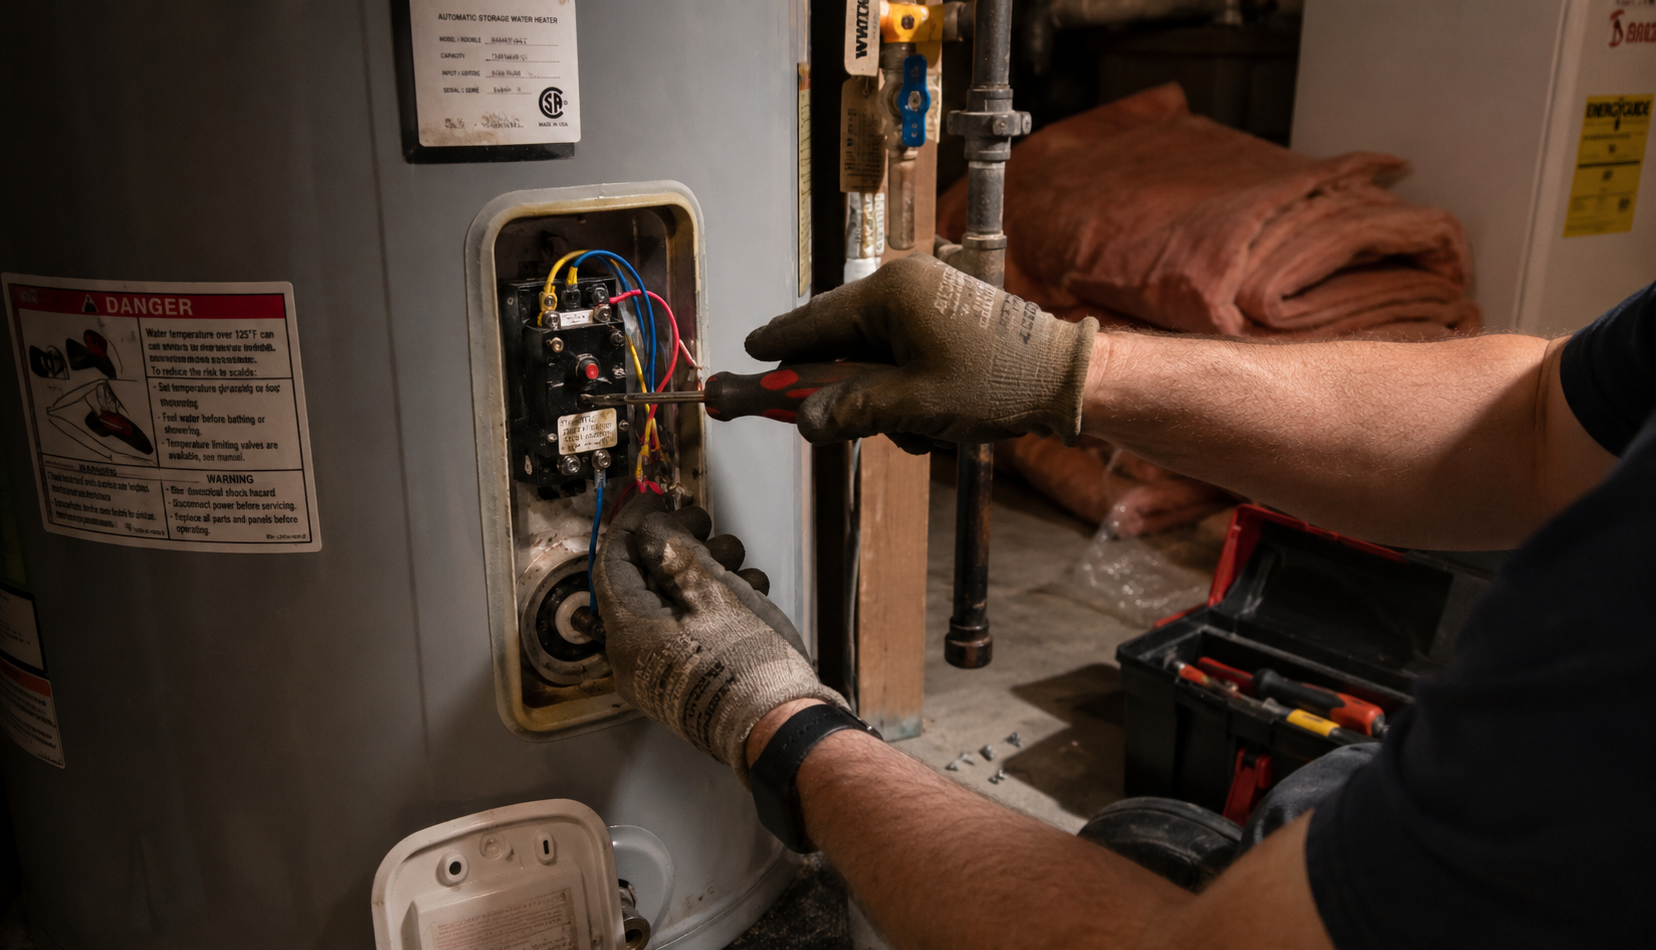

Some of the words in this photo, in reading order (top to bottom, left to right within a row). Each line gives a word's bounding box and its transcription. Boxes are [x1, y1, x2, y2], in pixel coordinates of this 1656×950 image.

[437, 13, 477, 22] AUTOMATIC
[479, 14, 510, 23] STORAGE
[510, 15, 534, 23] WATER
[534, 16, 558, 24] HEATER
[538, 86, 564, 119] CSA
[105, 296, 194, 317] DANGER
[145, 328, 168, 340] Water
[168, 329, 214, 340] temperature
[215, 331, 233, 340] over
[259, 331, 275, 340] can
[150, 365, 161, 375] To
[161, 366, 188, 377] reduce
[189, 367, 202, 377] the
[162, 412, 178, 422] Feel
[179, 413, 200, 423] water
[201, 414, 226, 424] before
[227, 414, 256, 426] bathing
[257, 415, 266, 424] or
[166, 438, 210, 450] Temperature
[211, 439, 239, 451] limiting
[240, 440, 265, 450] valves
[266, 442, 279, 450] are
[206, 474, 255, 485] WARNING
[249, 488, 276, 498] hazard
[212, 501, 235, 511] power
[236, 501, 260, 511] before
[261, 502, 298, 512] servicing.
[212, 515, 232, 525] parts
[233, 514, 247, 524] and
[248, 514, 273, 526] panels
[273, 515, 299, 525] before
